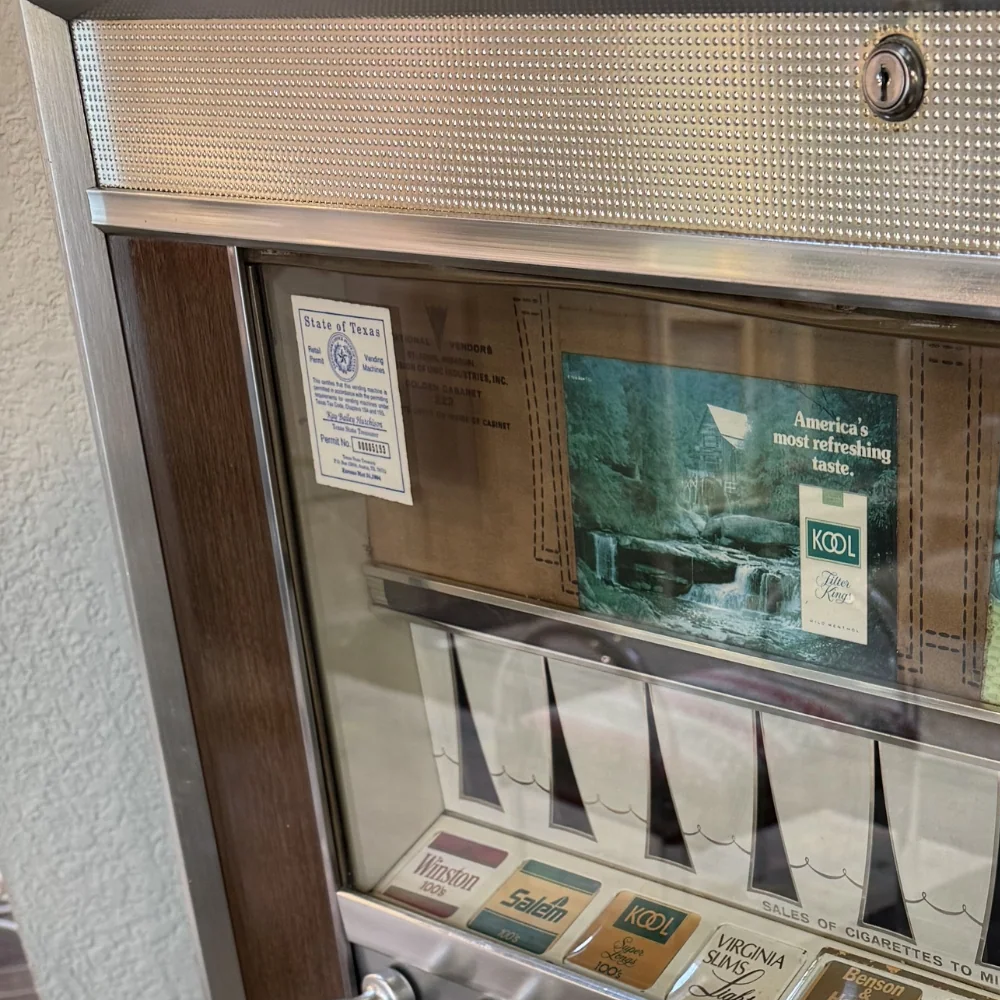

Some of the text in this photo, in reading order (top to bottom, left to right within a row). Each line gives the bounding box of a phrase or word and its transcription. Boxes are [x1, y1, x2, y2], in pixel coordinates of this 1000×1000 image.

[304, 316, 381, 337] State of Texas
[492, 375, 508, 386] INC.
[794, 410, 869, 438] America's
[320, 434, 340, 446] Permit
[341, 438, 351, 448] No.
[773, 431, 892, 464] most refreshing
[812, 457, 854, 476] taste.
[812, 528, 856, 558] KOOL
[816, 570, 850, 589] Filter
[413, 852, 480, 892] Winston
[419, 880, 447, 898] 100's
[500, 888, 568, 924] Salem
[623, 904, 674, 936] KOOL
[613, 936, 645, 957] Super
[762, 900, 810, 924] SALES
[817, 918, 838, 932] OF
[844, 926, 944, 968] CIGARETTES
[950, 960, 973, 977] TO
[600, 950, 638, 968] Longs
[702, 949, 750, 976] SLIMS
[717, 934, 786, 970] VIRGINIA
[594, 961, 623, 980] 100's
[842, 966, 906, 997] Benson
[859, 988, 872, 1000] &
